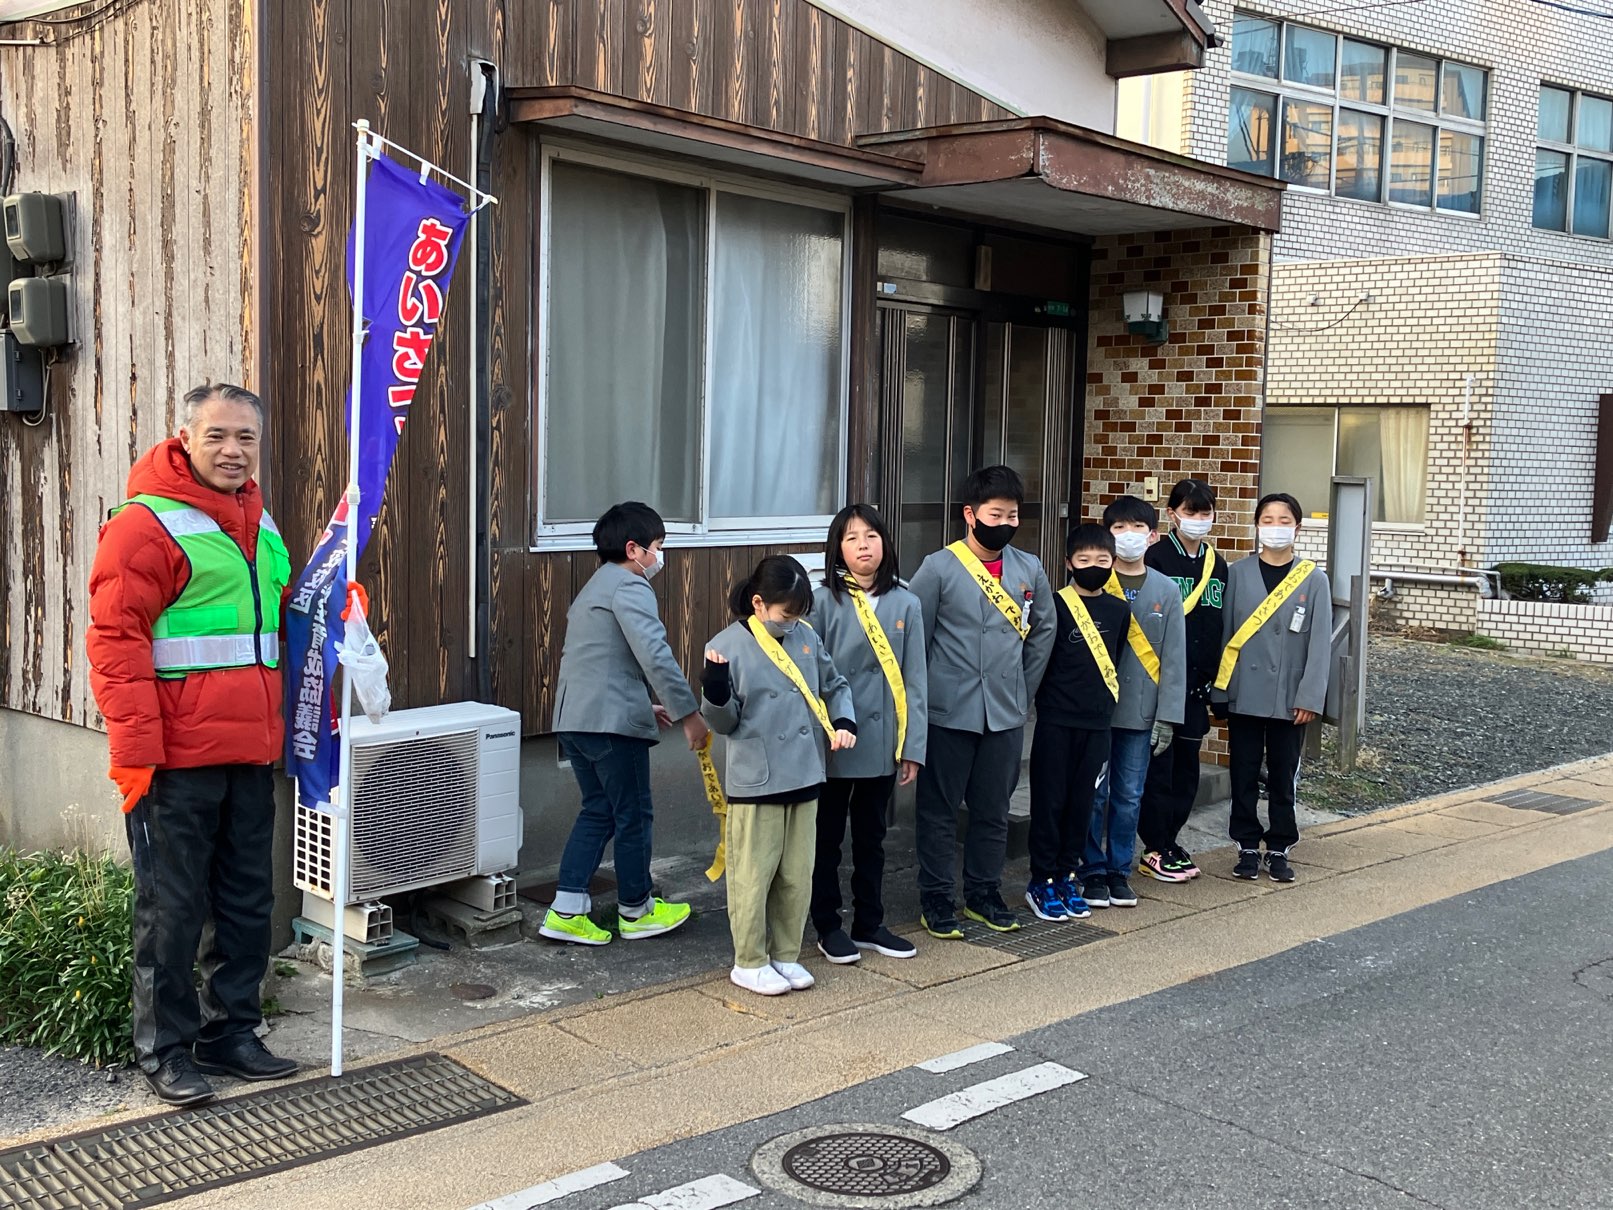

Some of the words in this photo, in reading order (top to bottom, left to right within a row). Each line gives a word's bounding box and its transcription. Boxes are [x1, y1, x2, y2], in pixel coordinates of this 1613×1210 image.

[977, 574, 1028, 636] えがおであ
[485, 730, 515, 740] Panasonic
